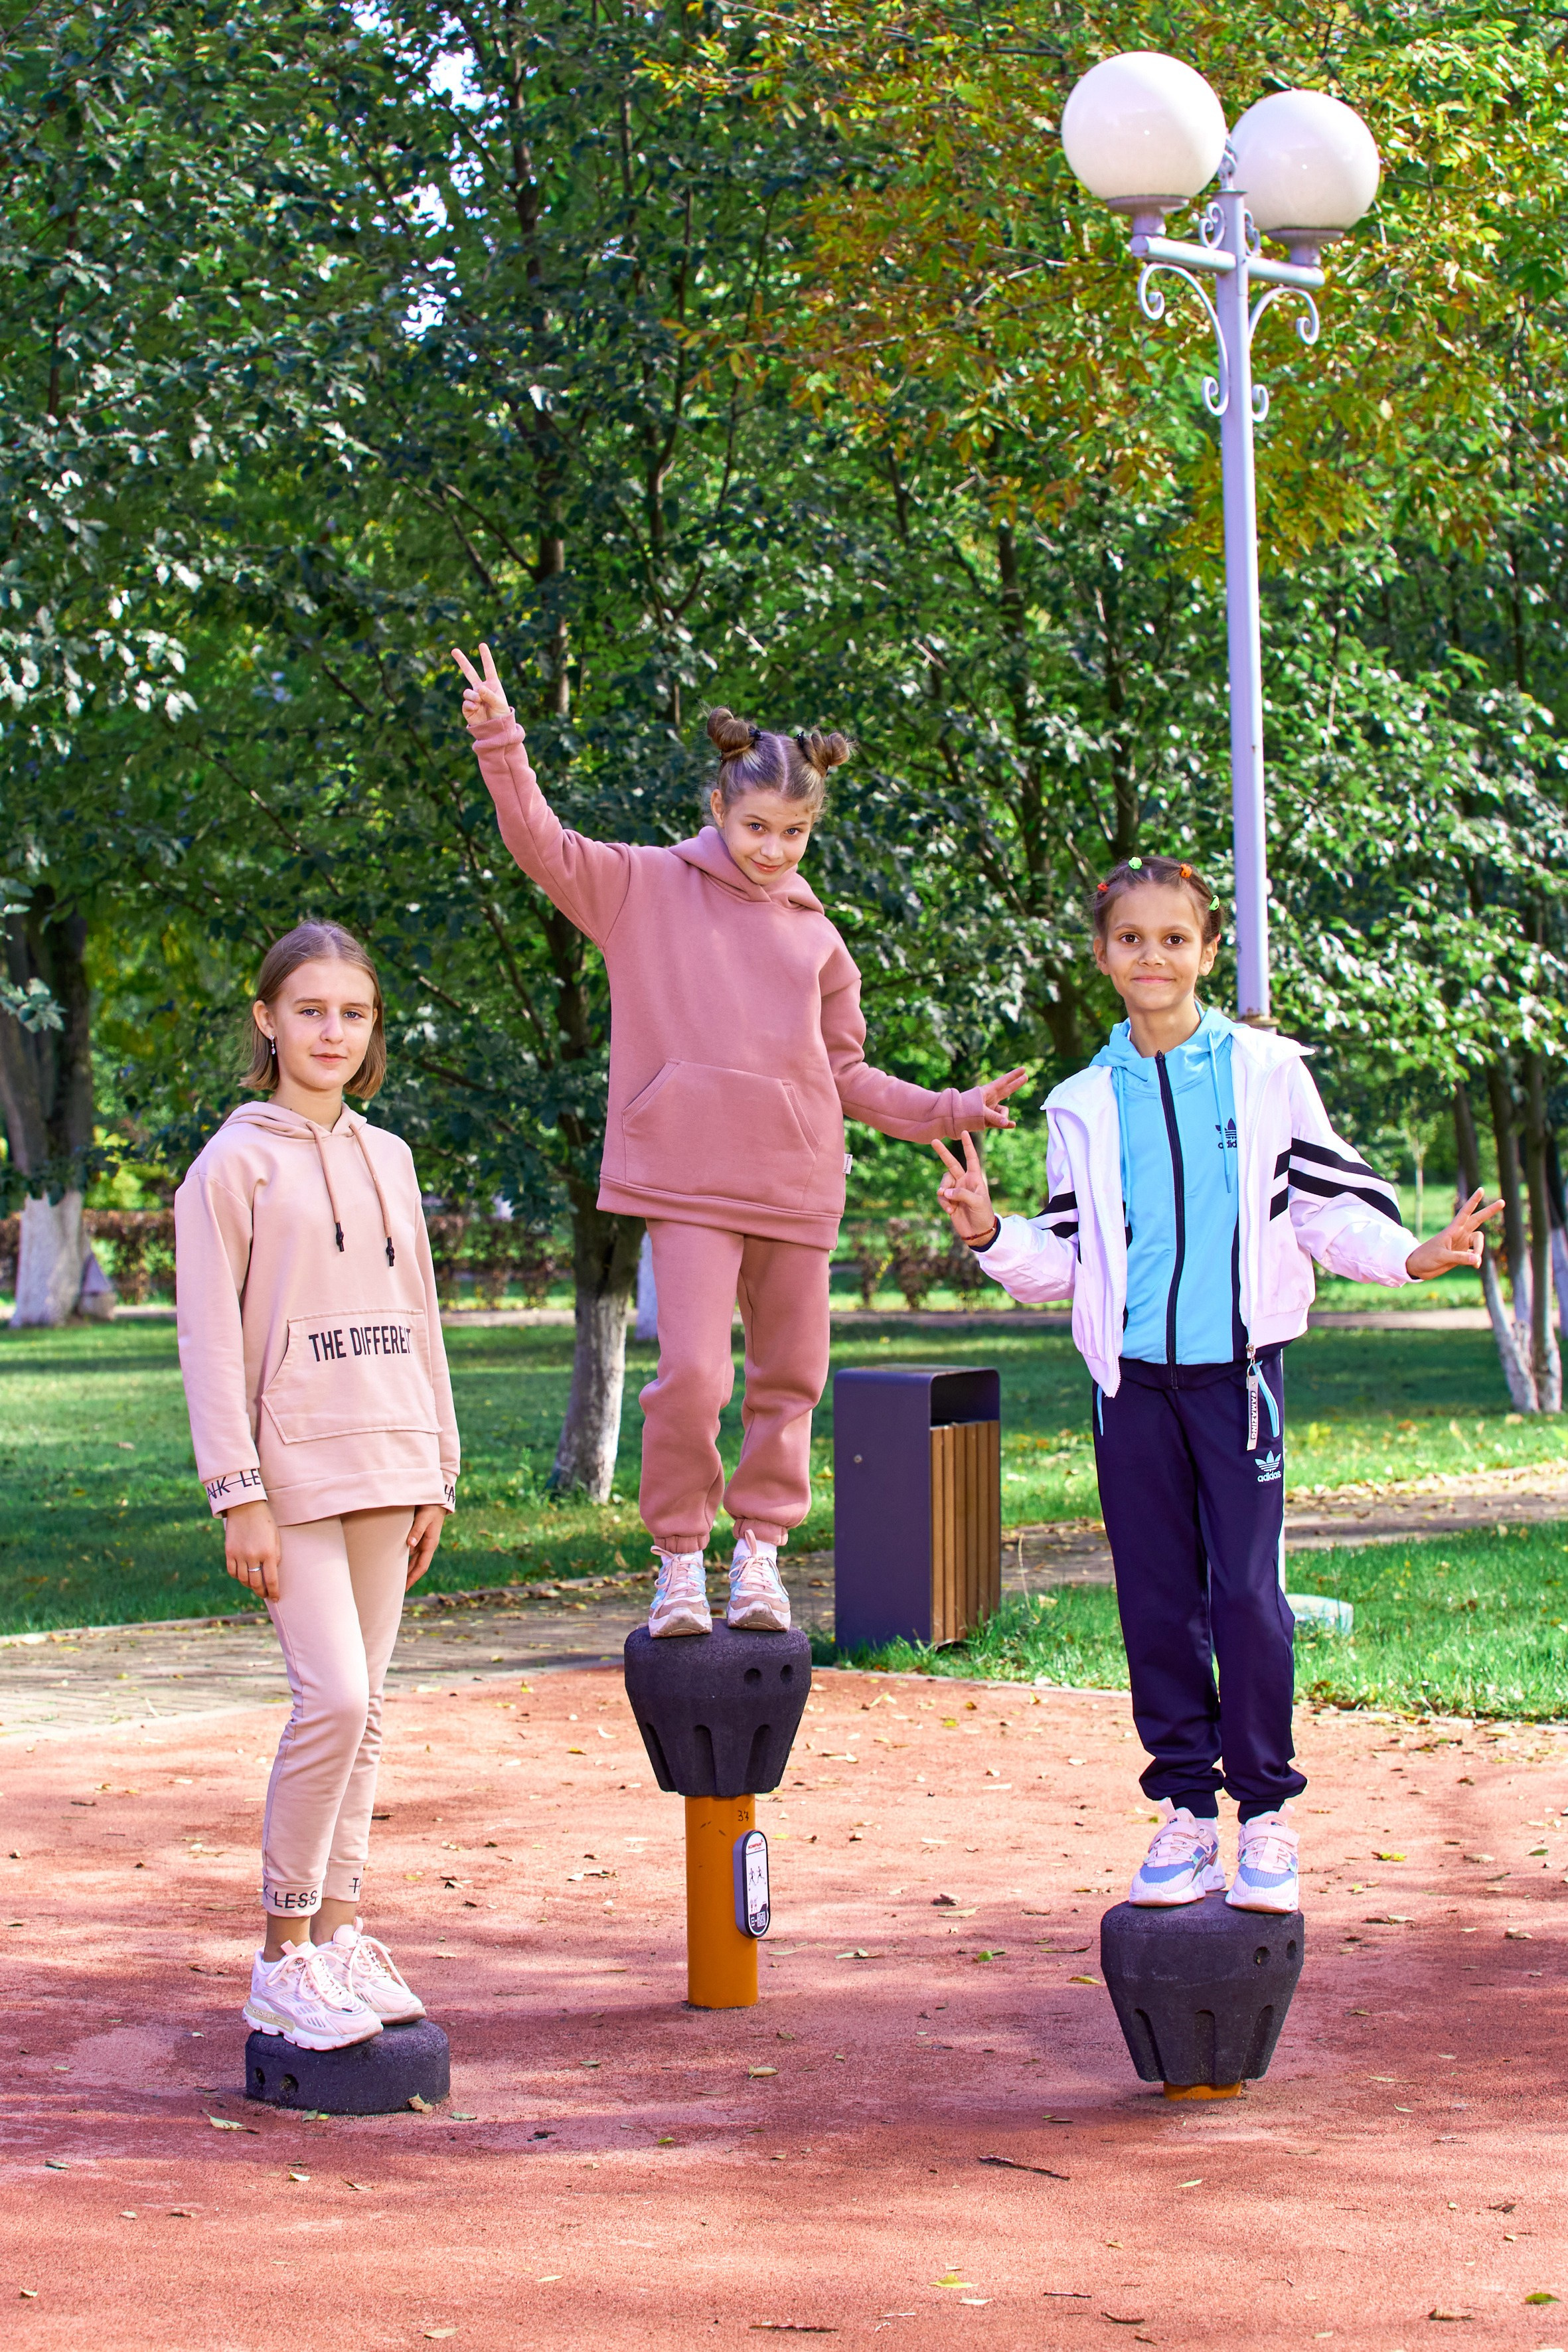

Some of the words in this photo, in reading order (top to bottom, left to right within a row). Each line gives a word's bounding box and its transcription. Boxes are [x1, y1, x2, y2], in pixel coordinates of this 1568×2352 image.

[308, 1329, 347, 1362] THE
[1257, 1470, 1282, 1482] adidas
[274, 1890, 317, 1909] LESS
